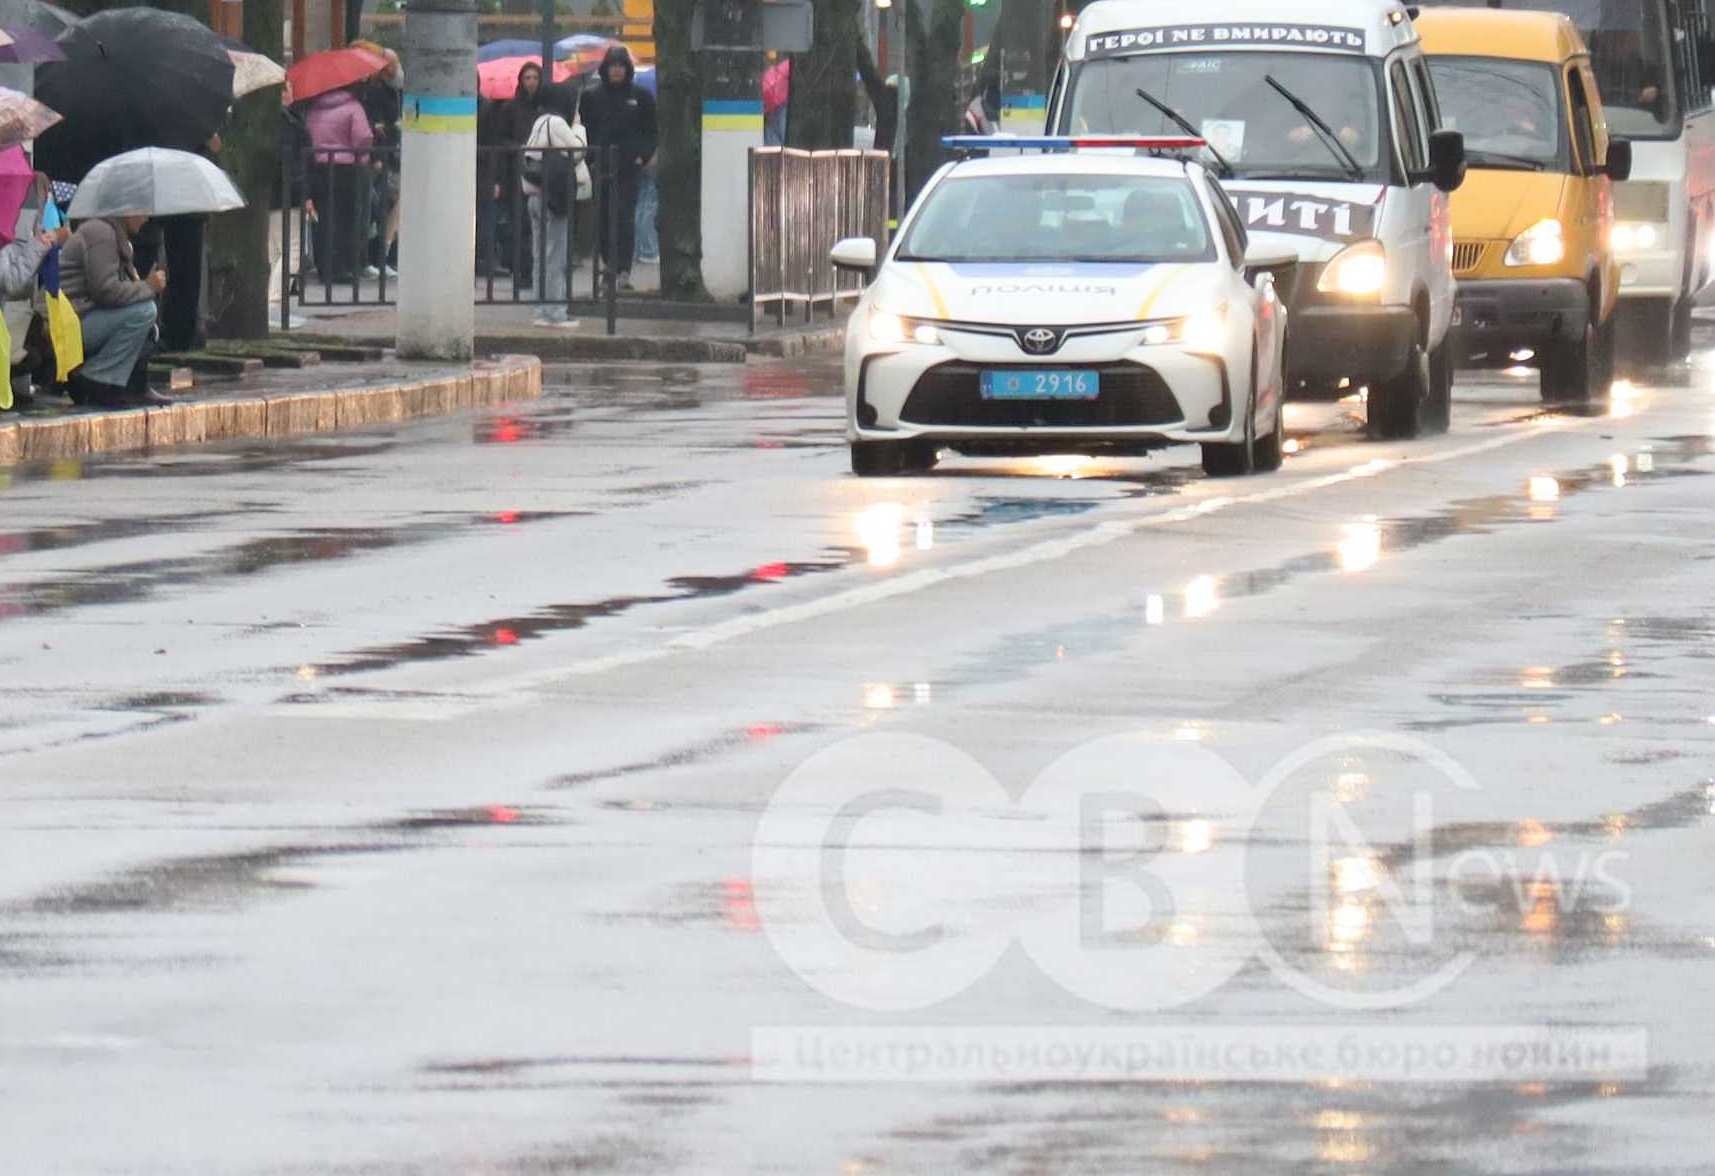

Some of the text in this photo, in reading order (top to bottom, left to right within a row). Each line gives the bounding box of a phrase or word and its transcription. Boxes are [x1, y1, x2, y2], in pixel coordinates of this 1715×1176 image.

[1213, 26, 1363, 47] ВМИРАЮТЬ
[1229, 196, 1353, 236] ИТІ
[1035, 374, 1087, 393] 2916
